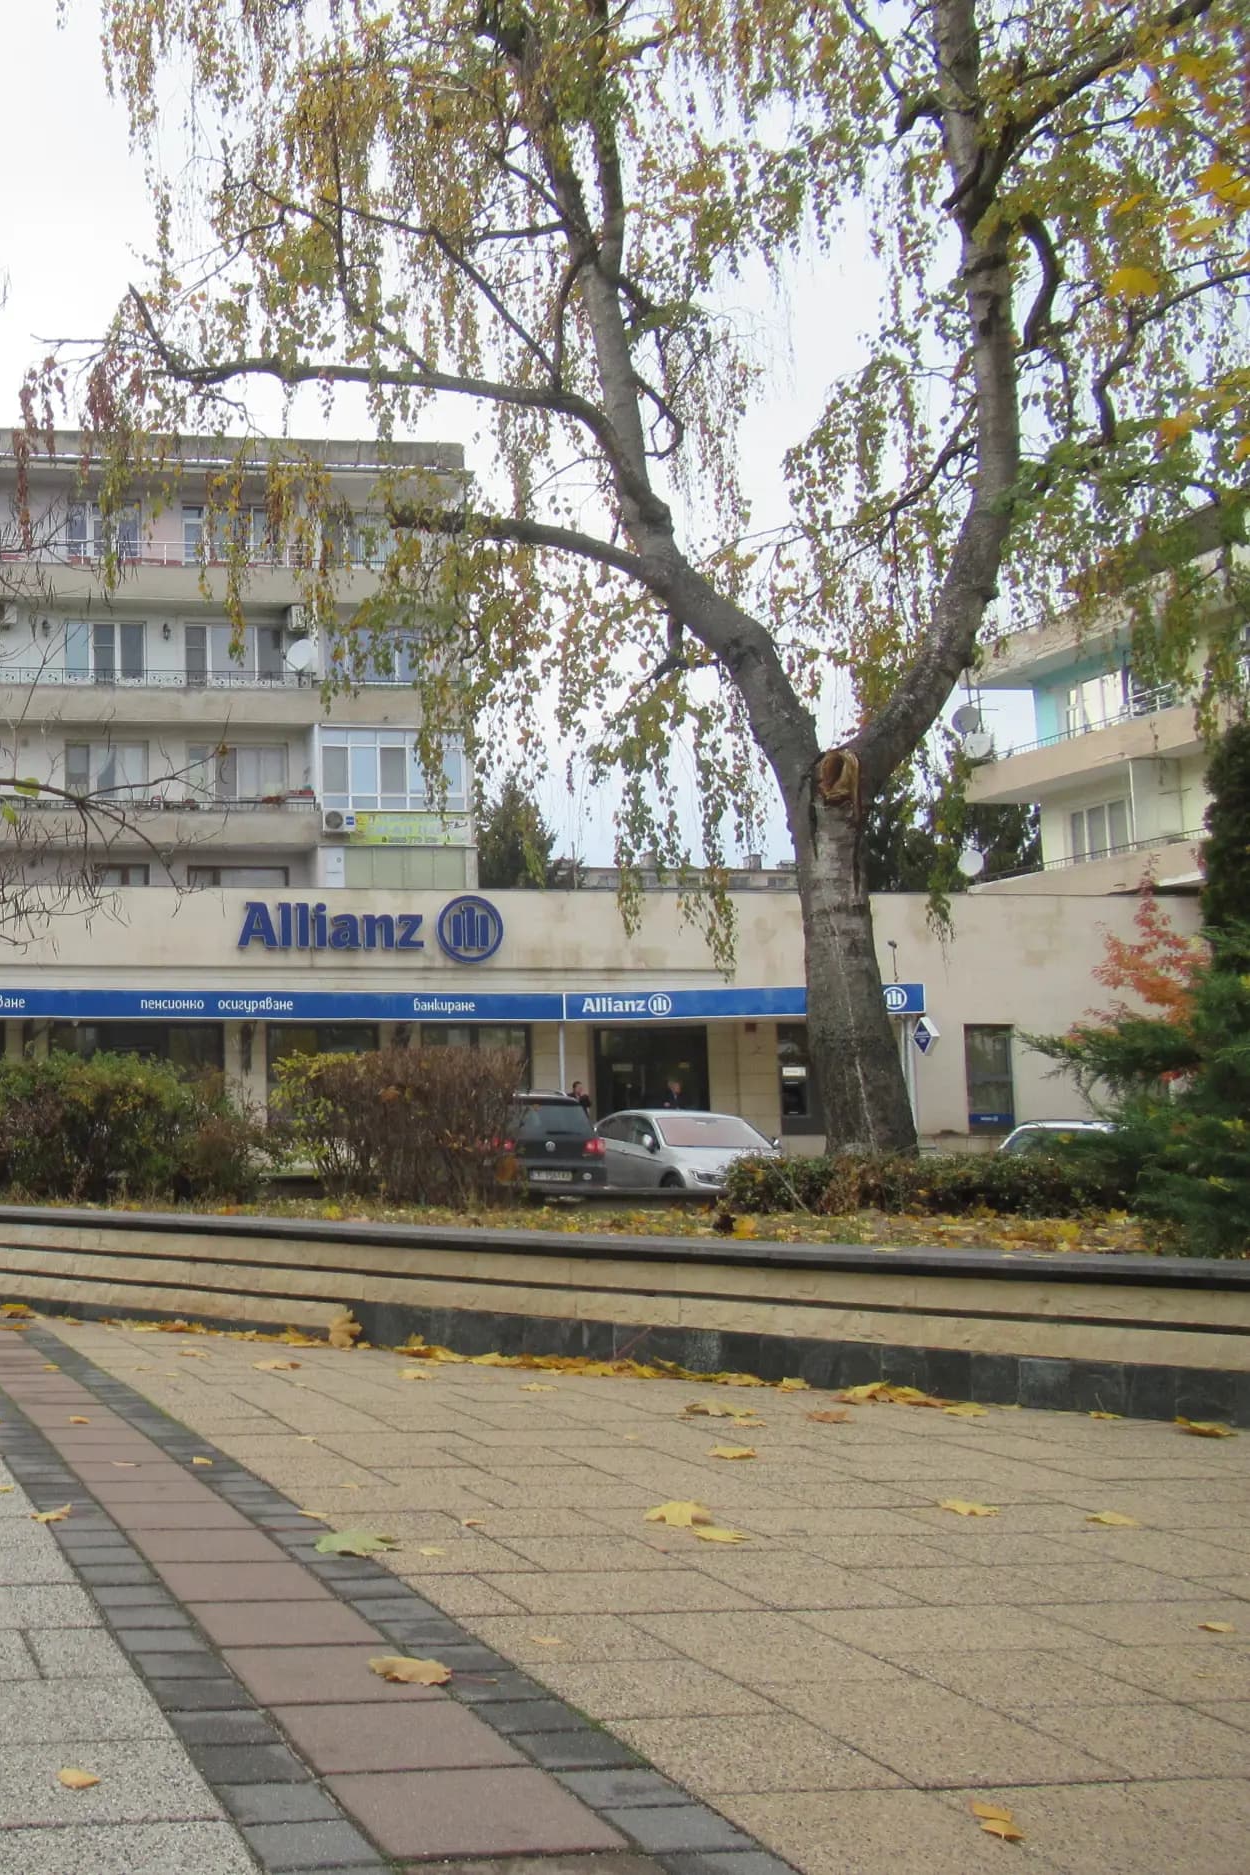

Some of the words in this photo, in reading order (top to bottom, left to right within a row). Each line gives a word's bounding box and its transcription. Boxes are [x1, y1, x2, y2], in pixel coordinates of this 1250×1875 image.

[237, 901, 425, 949] Allianz
[141, 999, 205, 1010] пенсионно
[217, 997, 294, 1013] осигуряване
[413, 997, 476, 1014] банкиране
[582, 997, 647, 1013] Allianz
